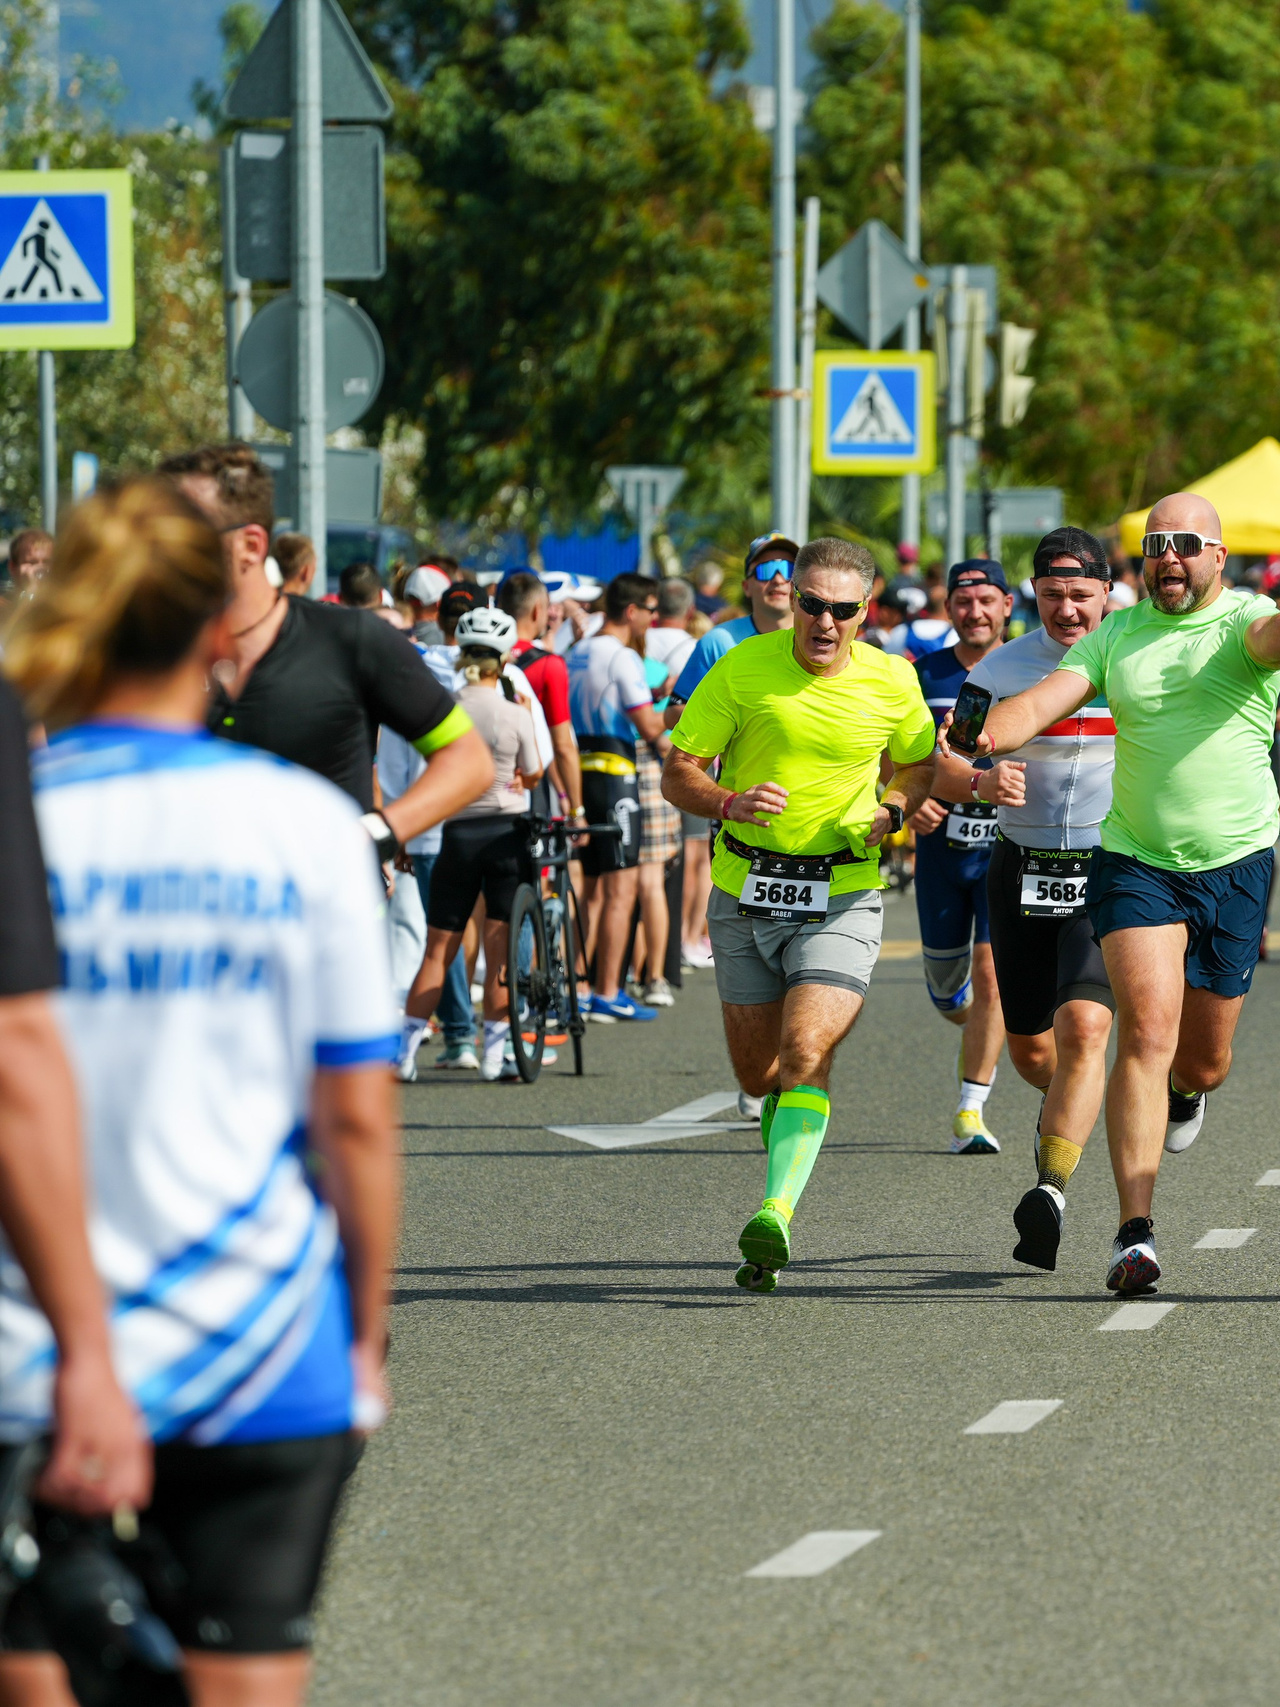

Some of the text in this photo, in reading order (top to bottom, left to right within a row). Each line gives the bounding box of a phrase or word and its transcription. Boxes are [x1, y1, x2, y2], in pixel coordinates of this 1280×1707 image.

[1029, 850, 1093, 860] POWERU
[753, 881, 813, 907] 5684
[1036, 881, 1087, 903] 5684
[770, 909, 792, 918] ПАВЕЛ
